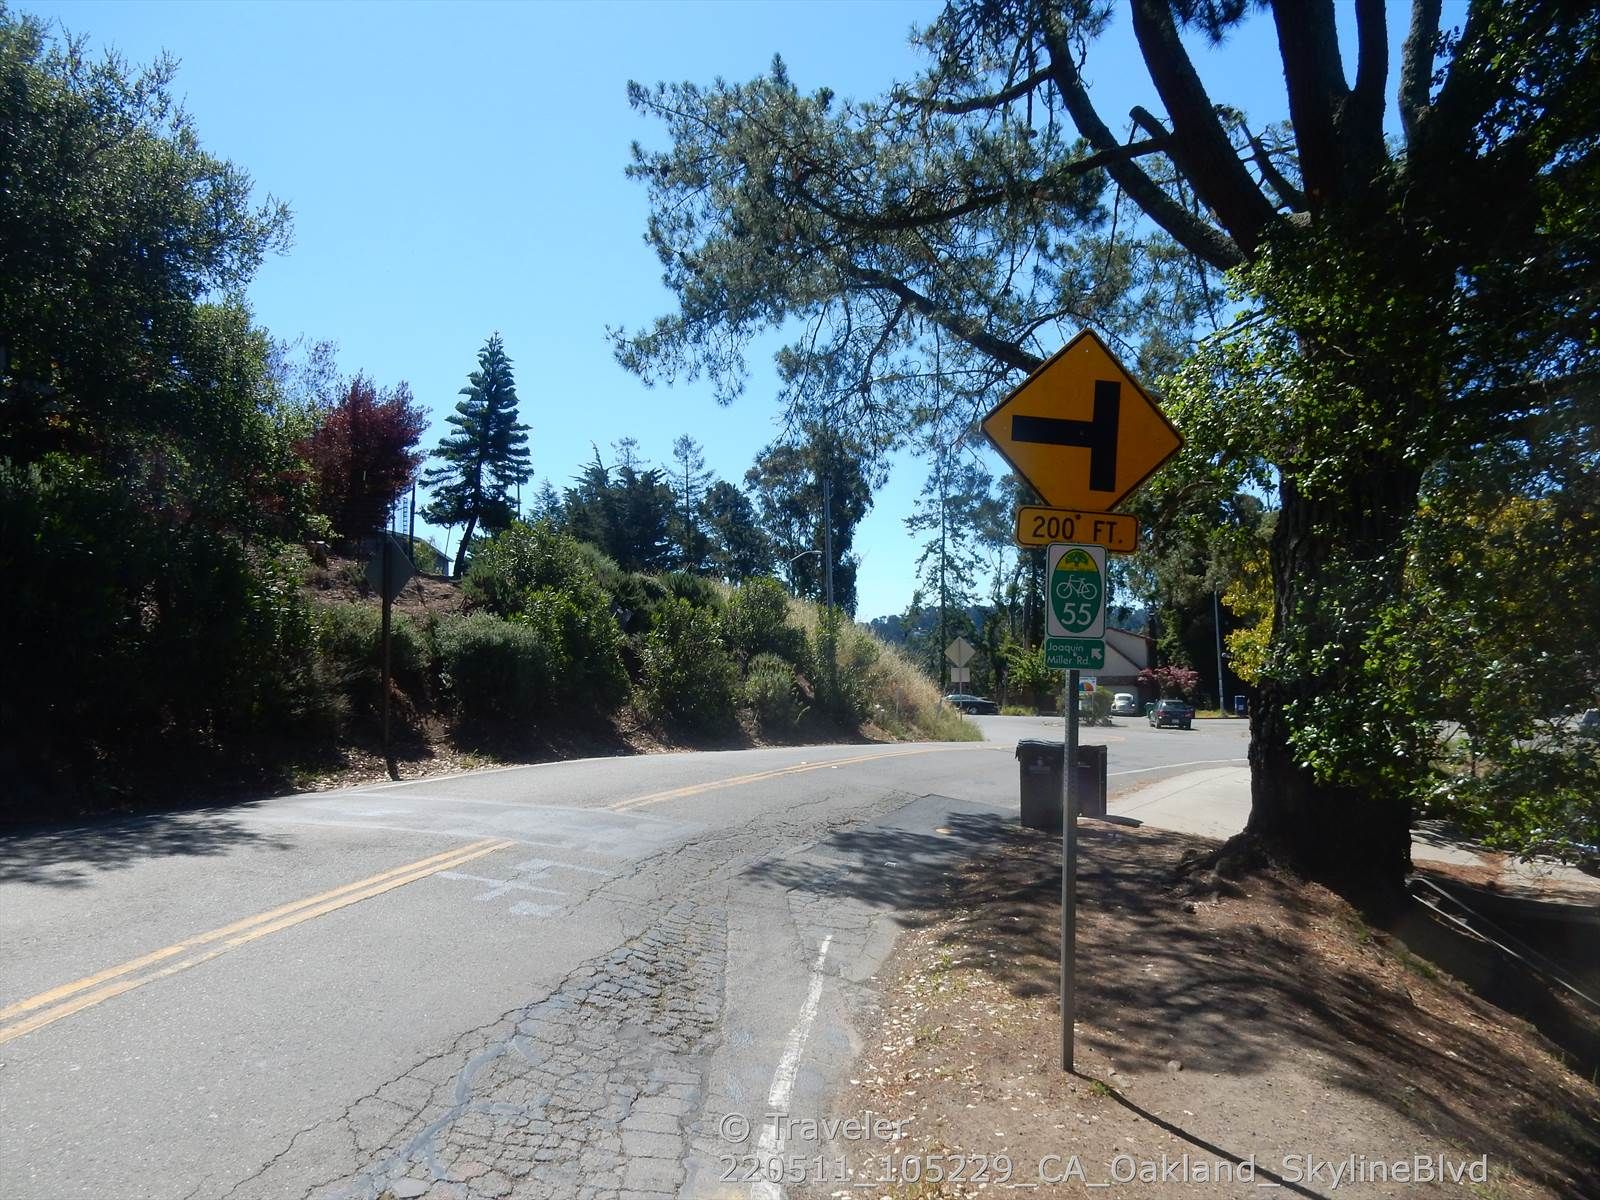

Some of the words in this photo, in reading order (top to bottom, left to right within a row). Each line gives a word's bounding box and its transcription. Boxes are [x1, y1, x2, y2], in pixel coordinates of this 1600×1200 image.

[1032, 516, 1075, 540] 200
[1092, 520, 1123, 543] FT.
[1061, 603, 1092, 625] 55
[1047, 643, 1084, 654] Joaquin
[1046, 656, 1072, 665] Miller
